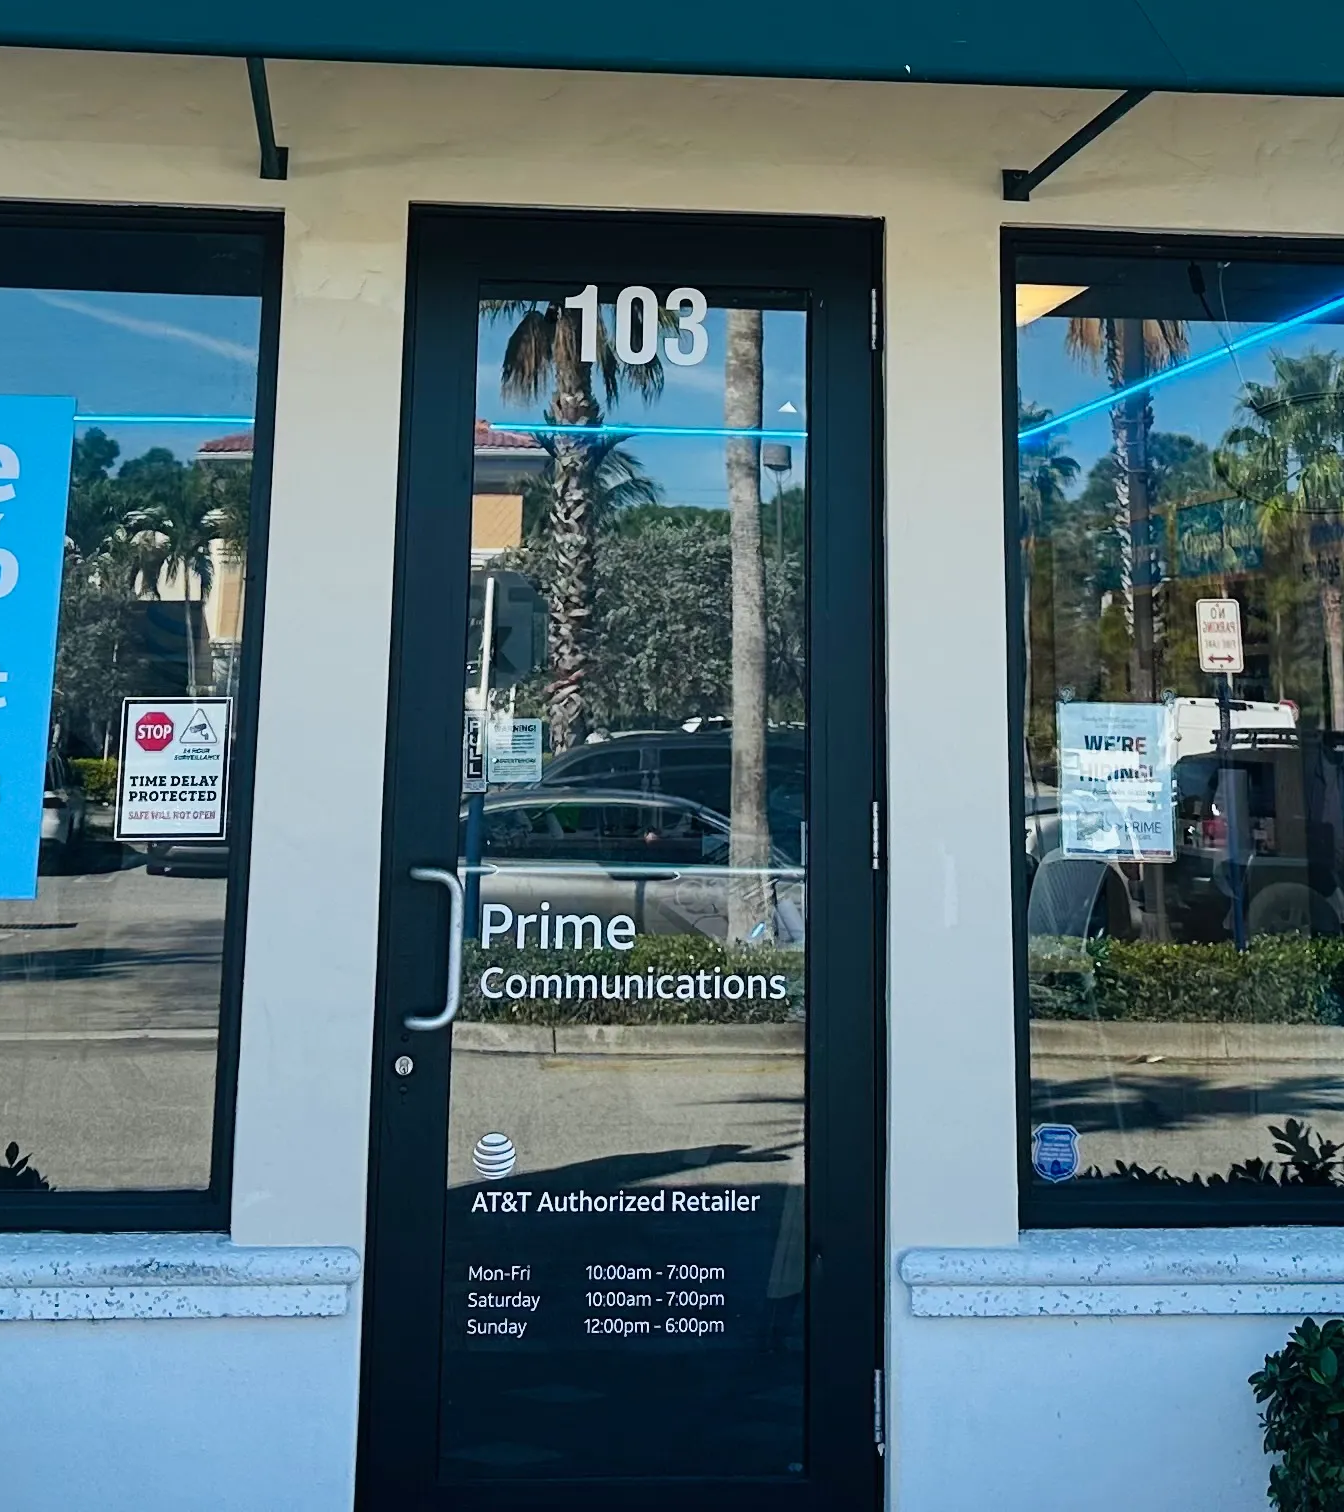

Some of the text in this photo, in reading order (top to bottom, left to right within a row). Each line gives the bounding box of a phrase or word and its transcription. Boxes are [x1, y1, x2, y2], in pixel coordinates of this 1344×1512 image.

[565, 285, 709, 367] 103
[137, 724, 173, 740] STOP
[1084, 735, 1147, 755] WE'RE
[129, 776, 219, 787] TIME DELAY
[128, 791, 217, 802] PROTECTED
[480, 901, 636, 951] Prime
[480, 966, 786, 1000] Communications
[471, 1190, 760, 1213] AT&T Authorized Retailer
[468, 1265, 531, 1281] Mon-Fri
[585, 1265, 651, 1280] 10:00am
[666, 1265, 725, 1283] 7:00pm
[467, 1291, 540, 1311] Saturday
[585, 1291, 651, 1307] 10:00am
[666, 1291, 725, 1310] 7:00pm
[466, 1318, 528, 1338] Sunday
[584, 1318, 650, 1337] 12:00pm
[665, 1318, 725, 1336] 6:00pm
